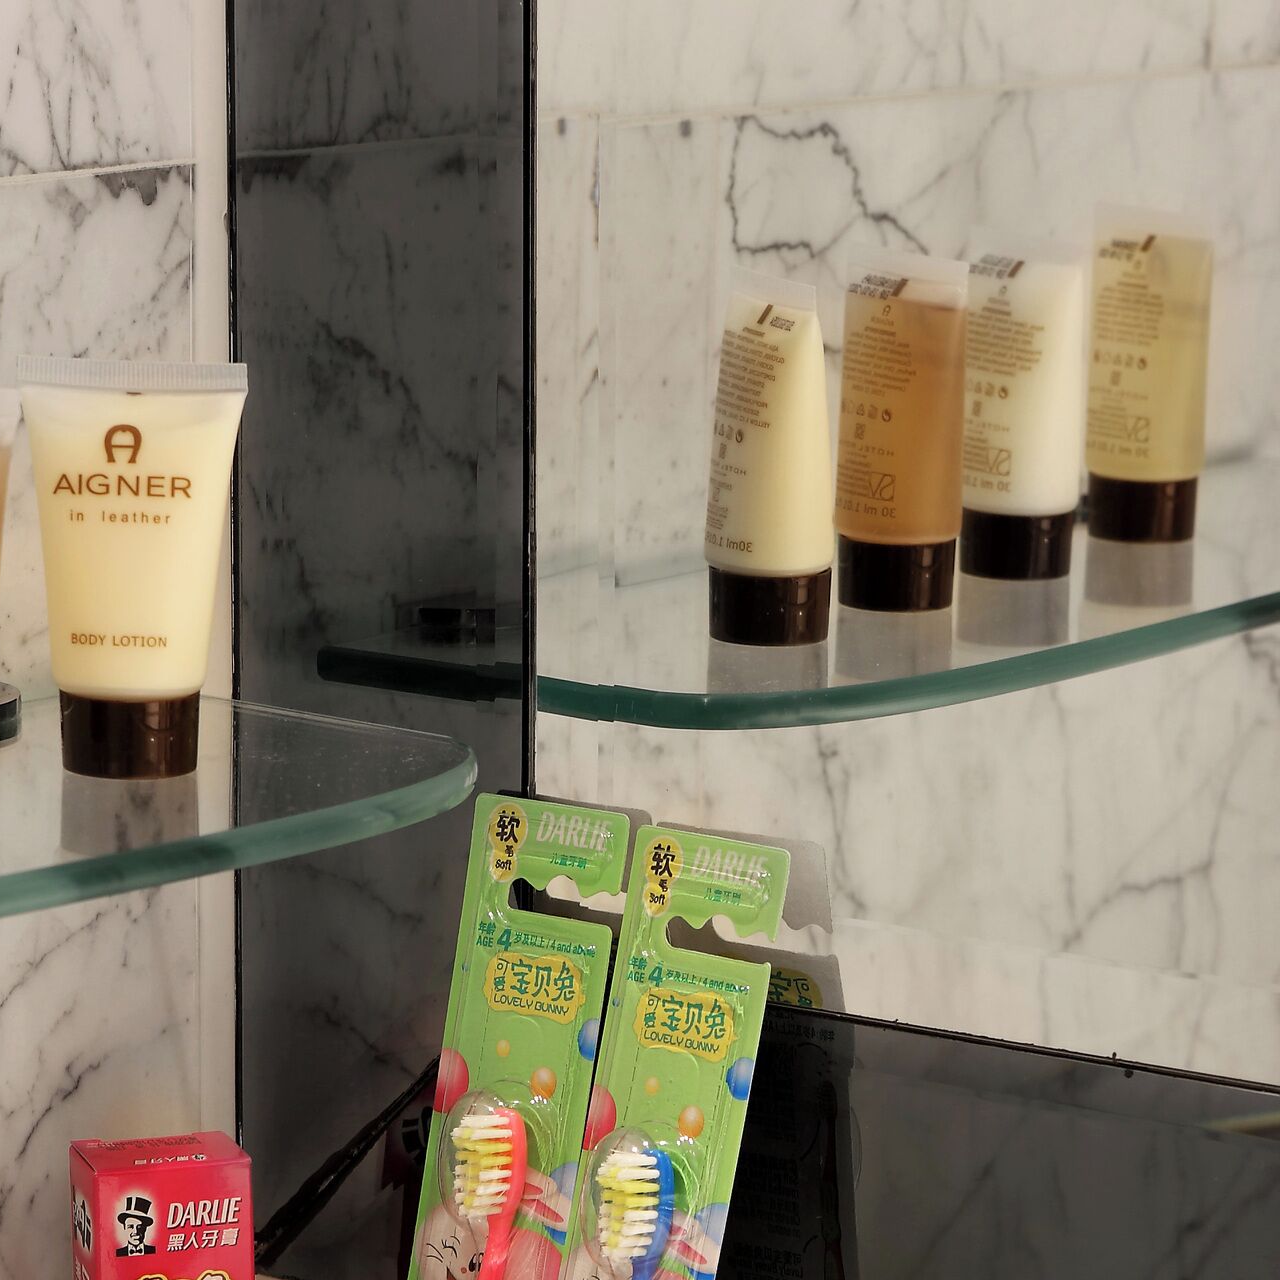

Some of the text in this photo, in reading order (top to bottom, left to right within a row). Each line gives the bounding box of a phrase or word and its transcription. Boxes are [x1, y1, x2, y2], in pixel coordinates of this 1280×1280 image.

[53, 473, 192, 499] AIGNER
[69, 510, 172, 525] in leather
[70, 633, 168, 649] BODY LOTION
[536, 812, 612, 853] DARLIE
[495, 859, 512, 871] Soft
[691, 846, 768, 887] DARLIE
[649, 893, 665, 905] Soft
[478, 921, 496, 935] 年龄
[476, 928, 512, 951] AGE 4
[557, 943, 571, 953] and
[629, 956, 647, 970] 年龄
[627, 966, 663, 987] AGE 4
[494, 994, 569, 1016] LOVELY BUNNY
[644, 1030, 719, 1053] LOVELY BUNNY
[167, 1197, 241, 1229] DARLIE
[167, 1228, 239, 1251] 黑人牙膏
